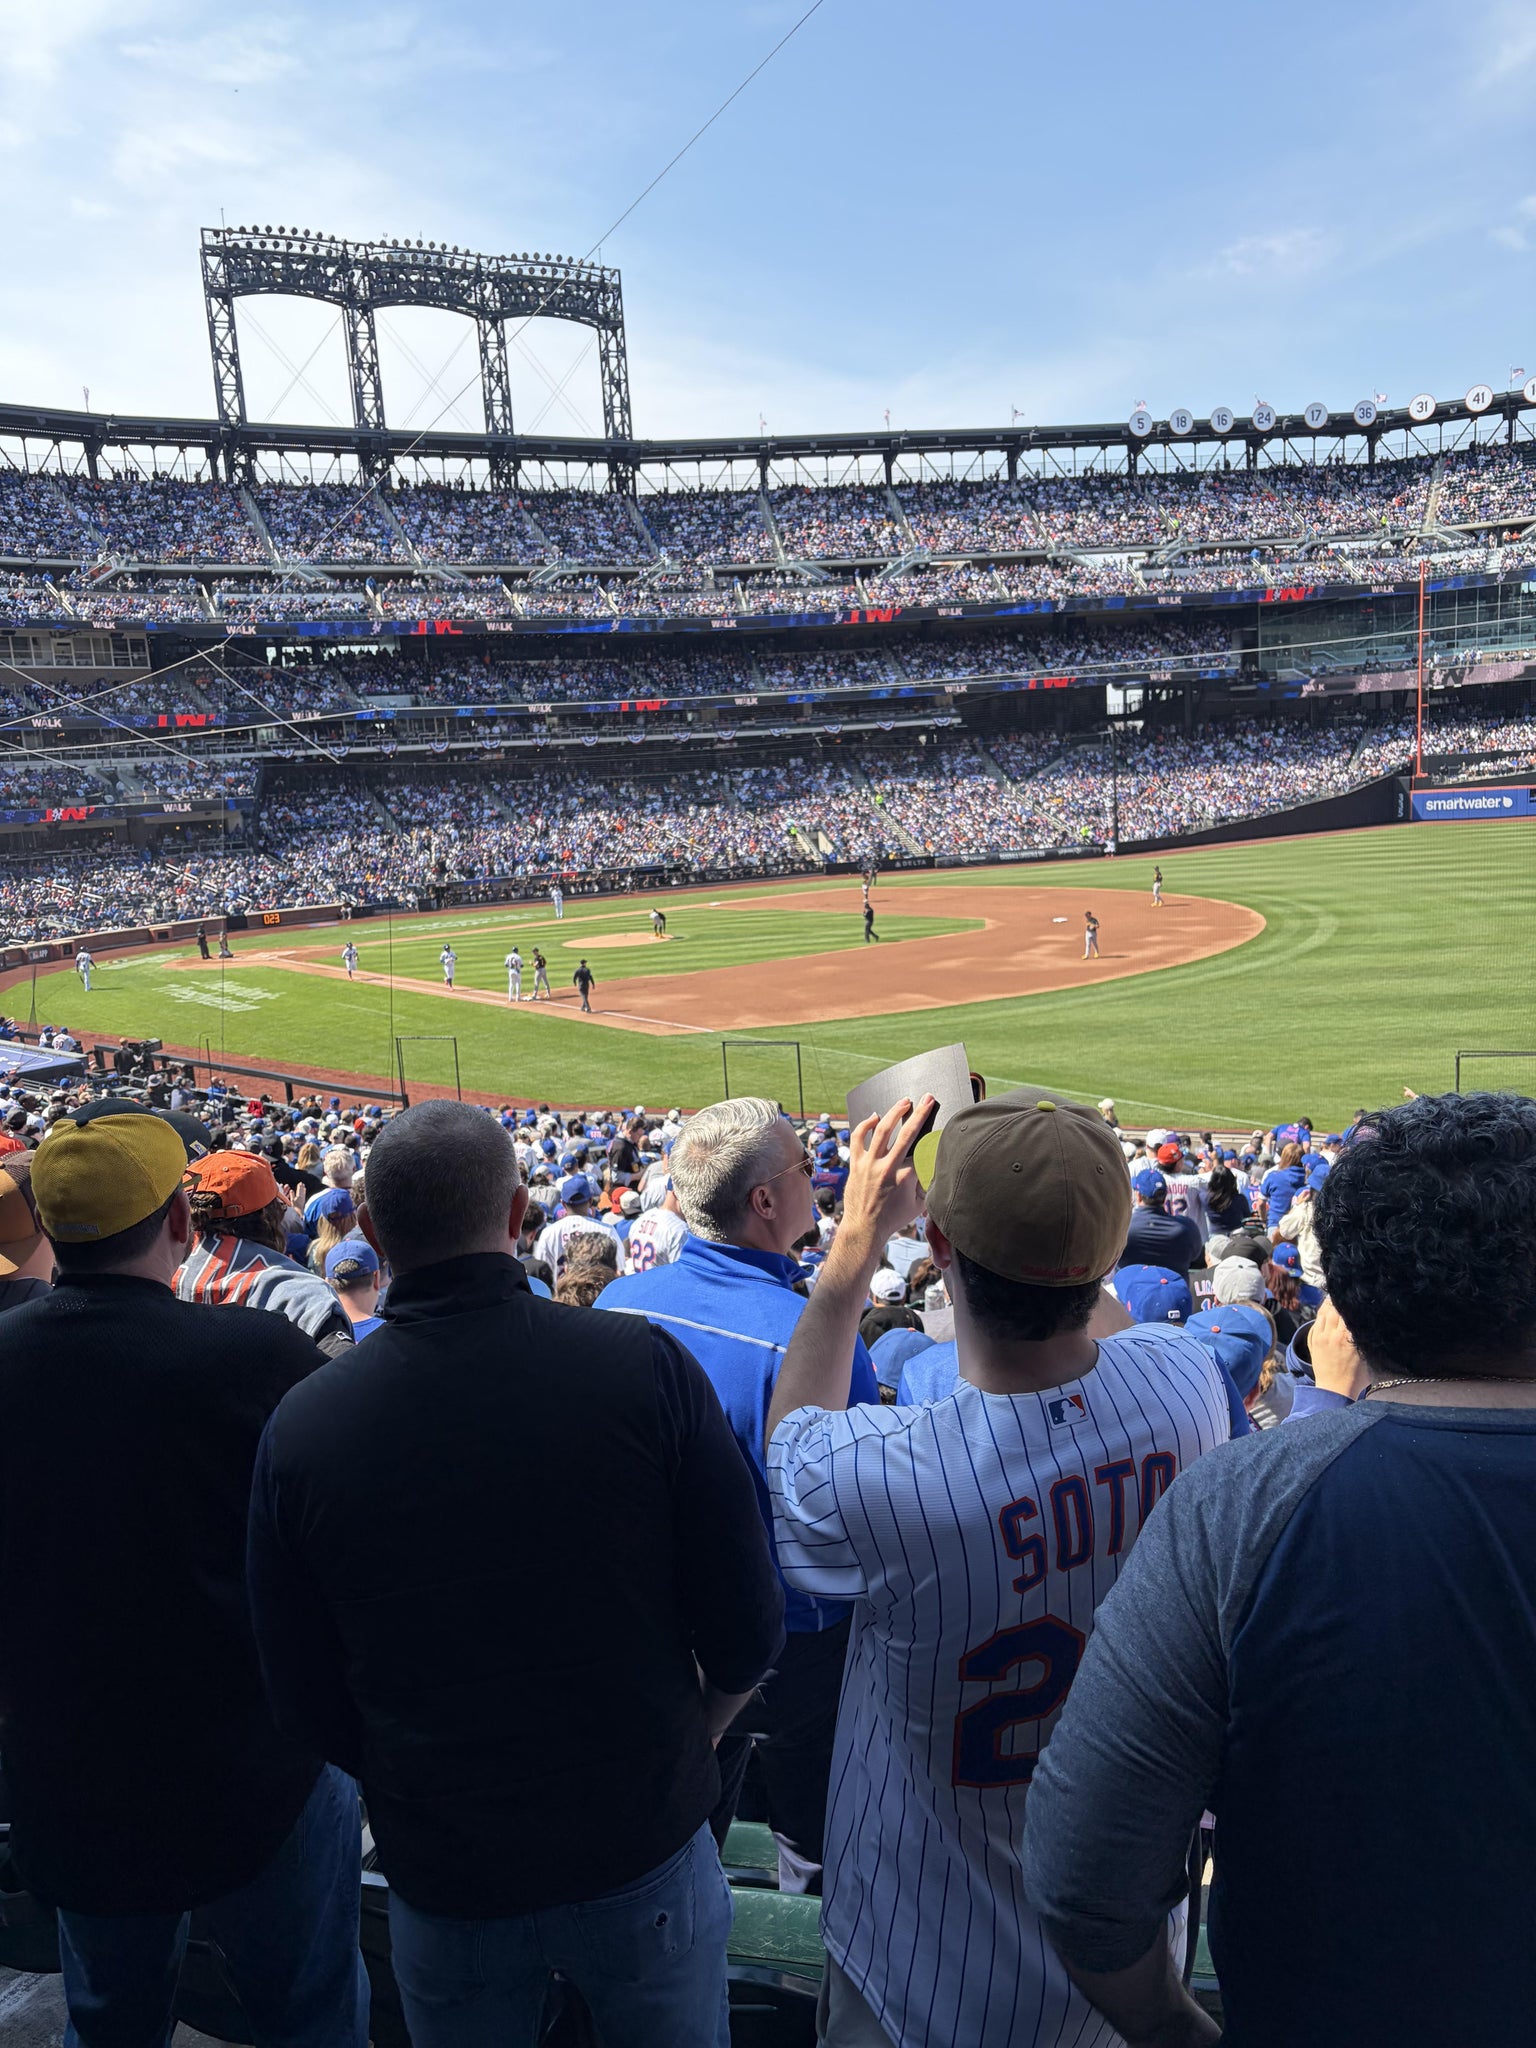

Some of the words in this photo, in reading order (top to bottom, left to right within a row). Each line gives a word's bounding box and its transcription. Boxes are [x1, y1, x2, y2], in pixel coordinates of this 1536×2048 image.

[1472, 391, 1485, 404] 41
[1416, 400, 1428, 413] 31
[1257, 411, 1271, 424] 24
[1311, 409, 1322, 422] 17
[1358, 407, 1372, 419] 36
[1137, 417, 1145, 430] 5
[1176, 415, 1187, 428] 18
[1217, 414, 1228, 426] 16
[1371, 585, 1394, 593] WALK
[1158, 596, 1182, 605] WALK
[937, 607, 963, 616] WALK
[92, 621, 116, 630] WALK
[225, 625, 257, 635] WALK
[486, 622, 513, 632] WALK
[711, 619, 737, 629] WALK
[1302, 683, 1325, 692] WAK
[32, 718, 62, 728] WALK
[163, 803, 192, 813] WALK
[1425, 796, 1501, 811] smartwater
[263, 912, 280, 925] 023
[631, 1238, 656, 1274] 22
[998, 1451, 1176, 1594] SOTO
[952, 1613, 1087, 1788] 2
